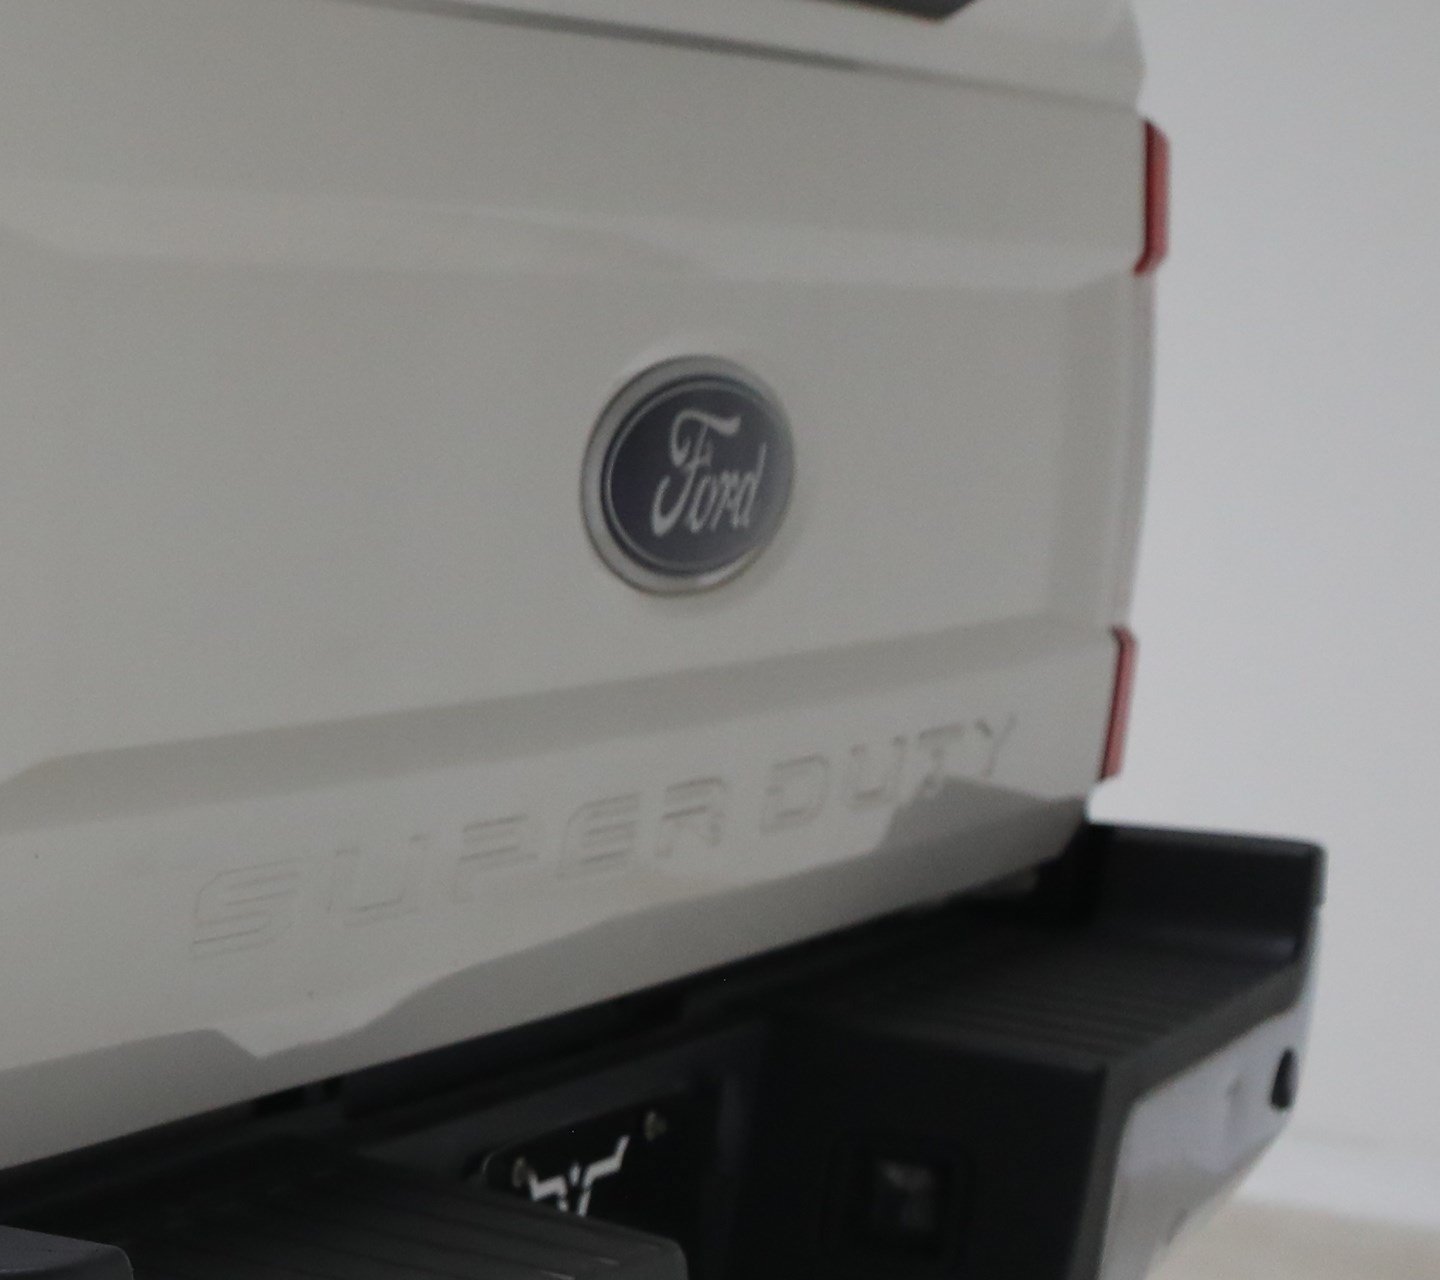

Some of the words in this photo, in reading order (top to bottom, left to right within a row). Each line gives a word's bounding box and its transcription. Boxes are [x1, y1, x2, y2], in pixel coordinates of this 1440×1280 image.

[650, 408, 768, 538] Ford
[189, 776, 729, 960] SUPER
[758, 713, 1019, 837] DUTY
